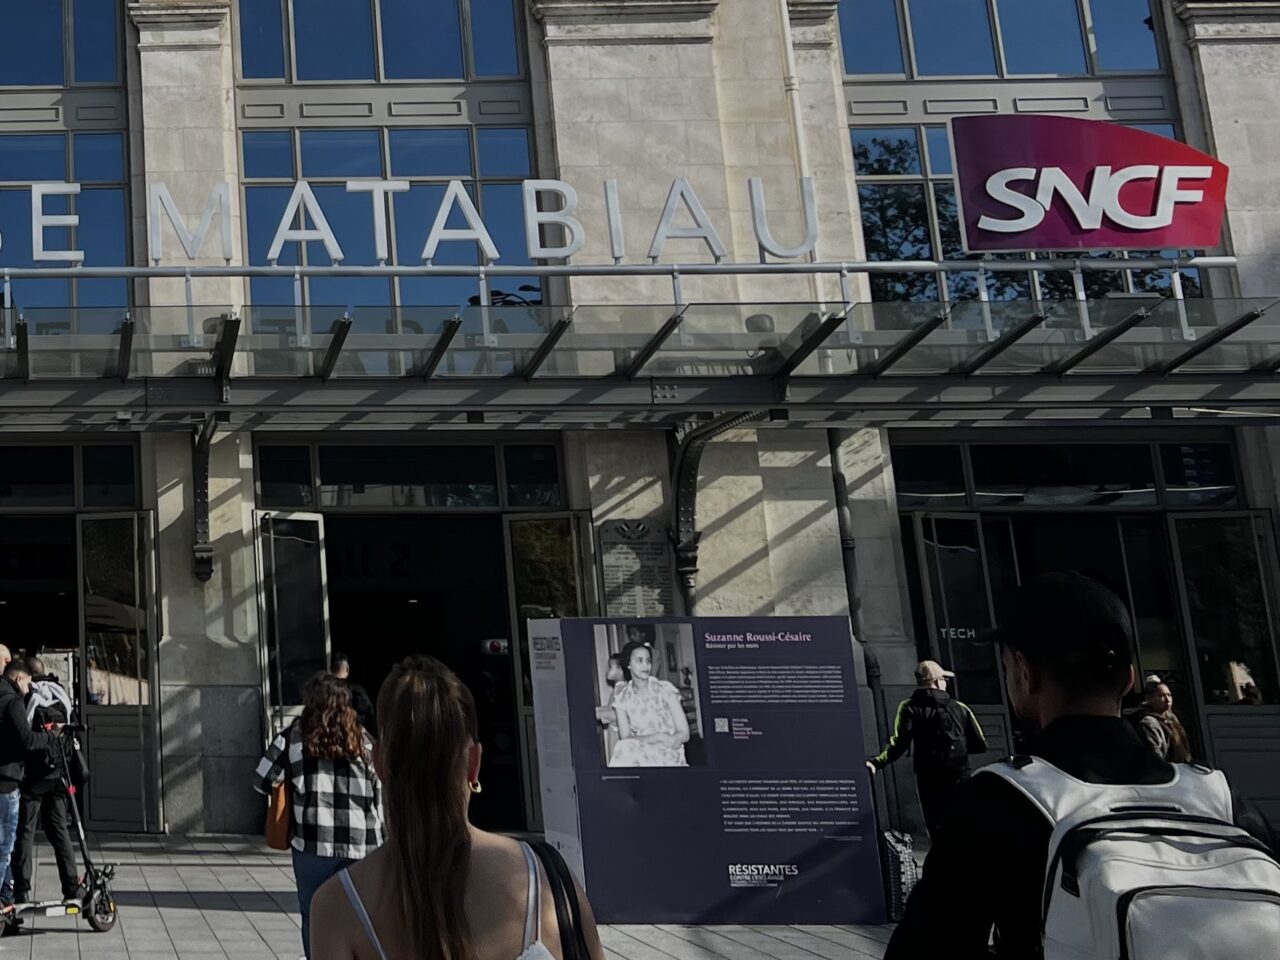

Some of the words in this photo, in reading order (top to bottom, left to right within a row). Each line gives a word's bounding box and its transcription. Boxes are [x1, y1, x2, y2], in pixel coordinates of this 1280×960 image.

[977, 165, 1213, 233] SNCF
[150, 176, 820, 262] MATABIAU
[704, 632, 744, 642] Suzanne
[746, 631, 812, 642] Roussi-Césaire
[940, 627, 976, 639] TECH
[728, 863, 799, 875] RÉSISTANTES
